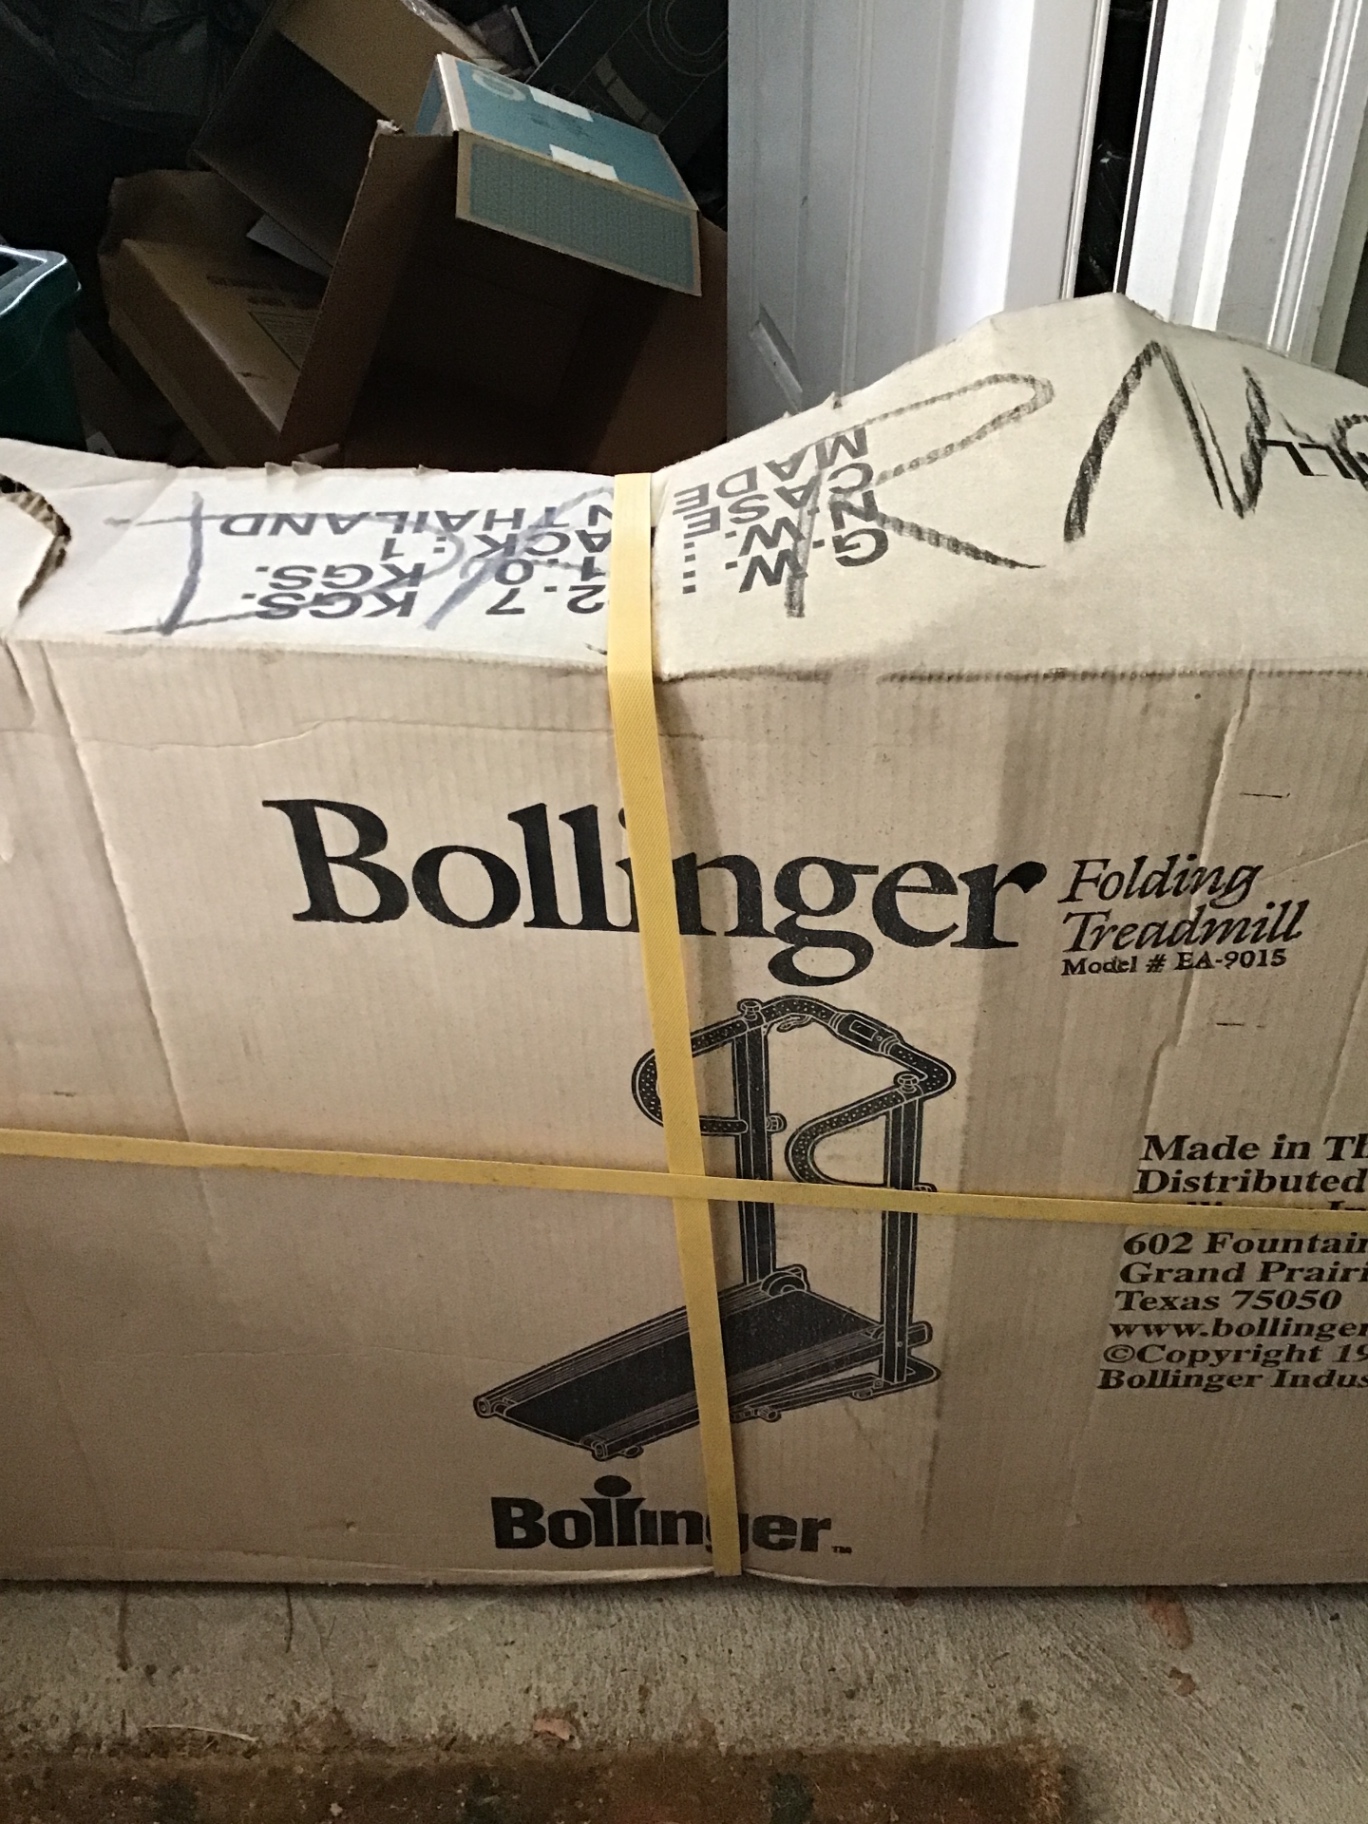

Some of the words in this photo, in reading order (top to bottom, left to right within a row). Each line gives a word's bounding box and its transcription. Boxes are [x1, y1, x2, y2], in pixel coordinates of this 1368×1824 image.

[673, 427, 868, 515] MADE
[684, 463, 874, 539] CASE
[220, 506, 570, 538] THAILAND
[588, 504, 612, 527] N
[380, 538, 405, 561] 1
[474, 530, 612, 558] ACK
[254, 562, 425, 590] KGS.
[241, 590, 418, 620] KGS.
[1057, 853, 1264, 909] Folding
[1062, 900, 1310, 952] Treadmill
[1060, 956, 1137, 976] Model
[1146, 953, 1167, 974] #
[1174, 947, 1287, 971] EA-9015
[1138, 1134, 1260, 1161] Made
[1269, 1133, 1311, 1160] in
[1132, 1167, 1368, 1194] Distributed
[1123, 1231, 1193, 1255] 602
[1119, 1261, 1247, 1284] Grand
[1114, 1290, 1220, 1312] Texas
[1231, 1289, 1343, 1311] 75050
[1097, 1369, 1263, 1393] Bollinger
